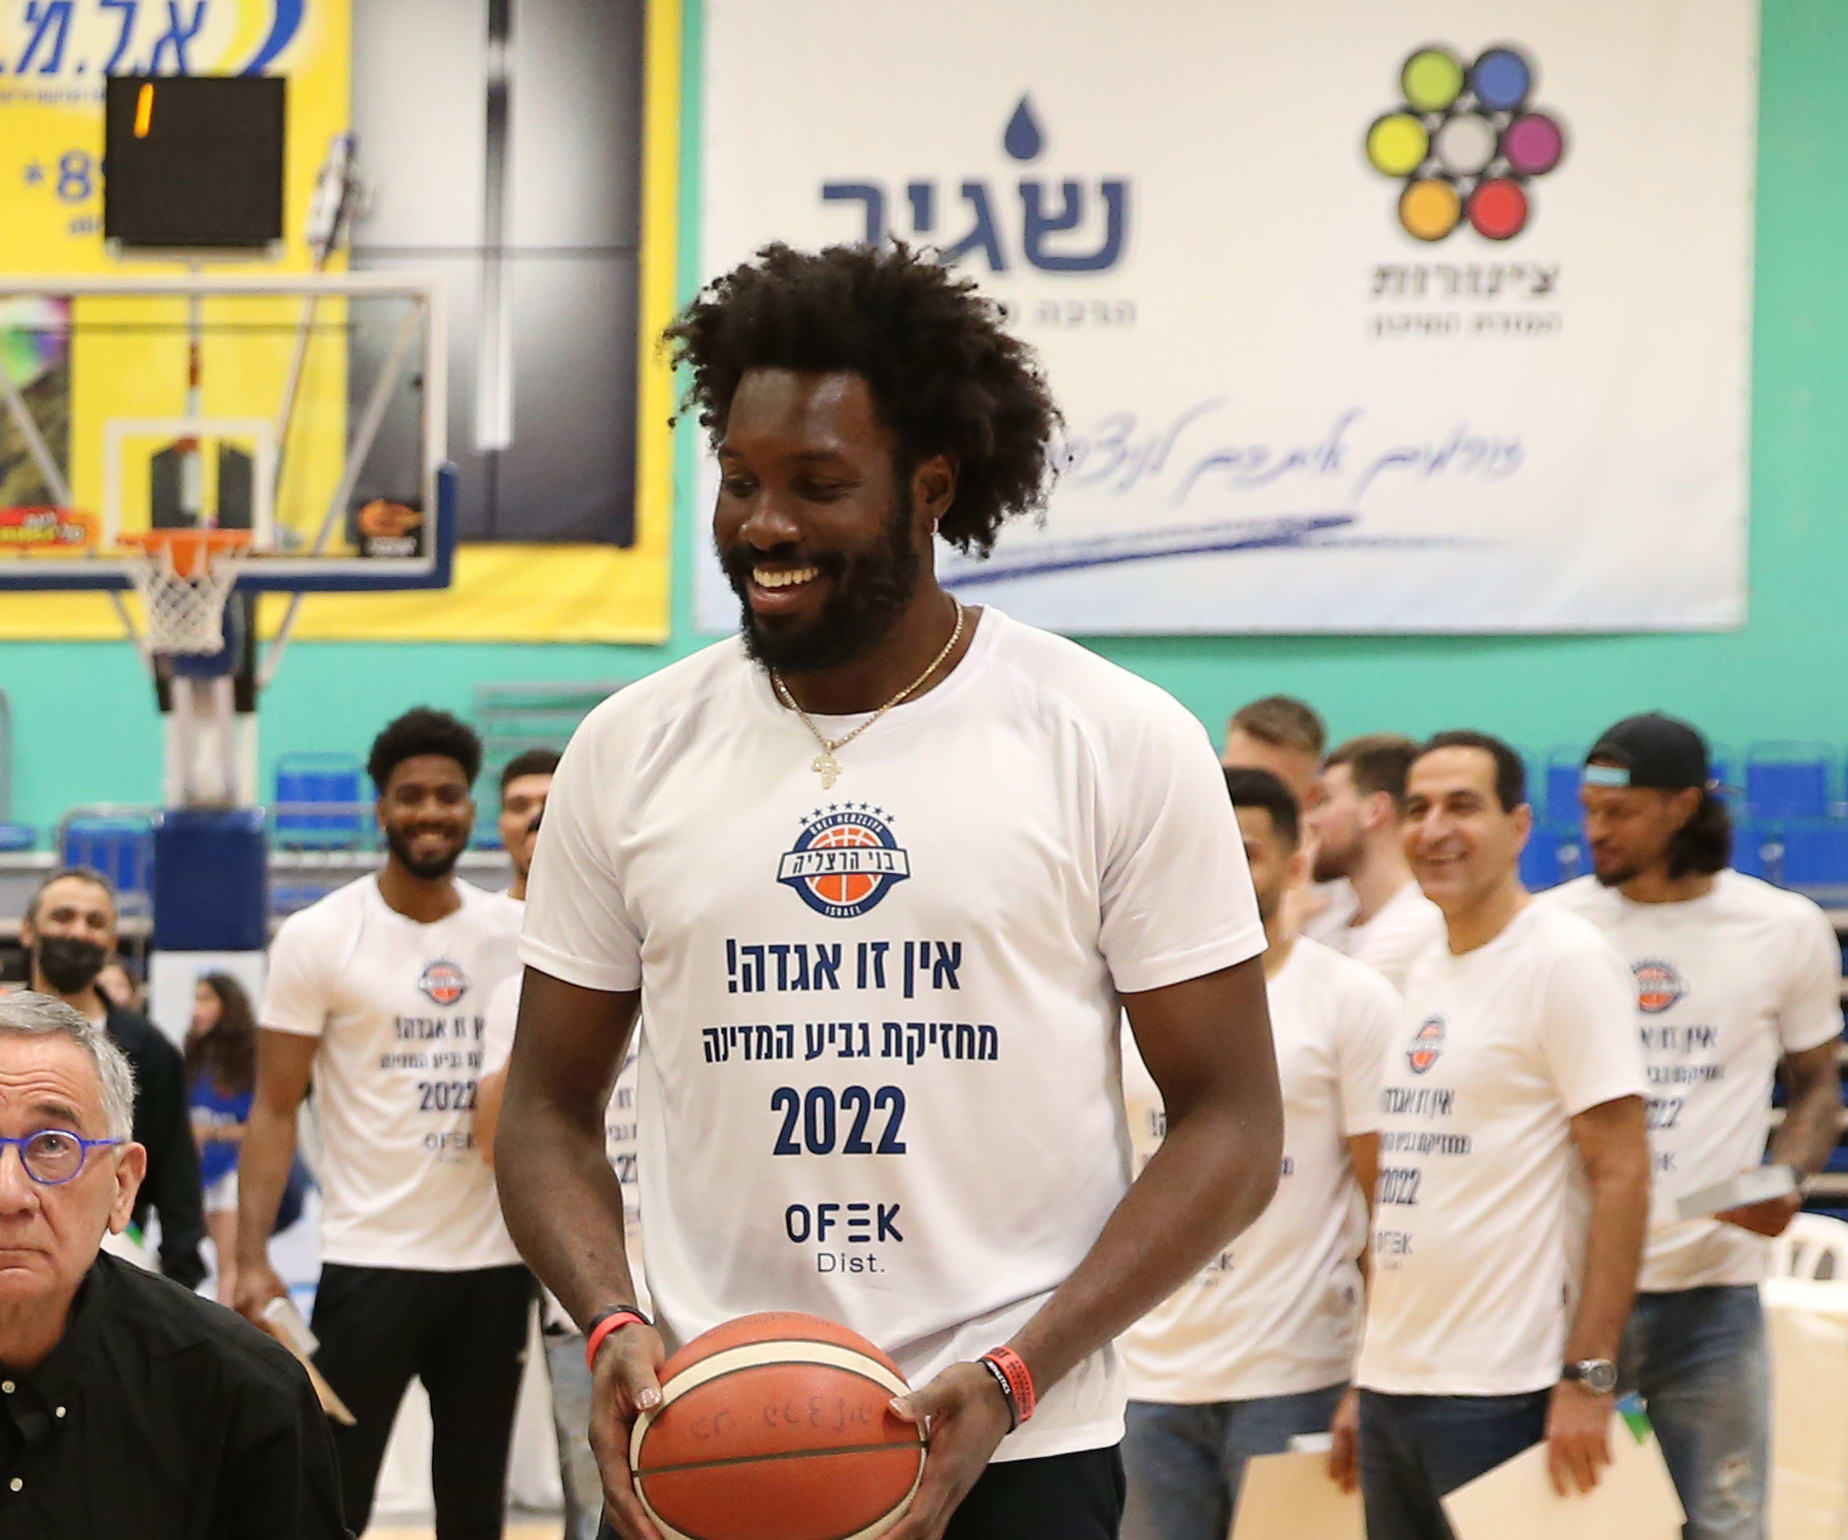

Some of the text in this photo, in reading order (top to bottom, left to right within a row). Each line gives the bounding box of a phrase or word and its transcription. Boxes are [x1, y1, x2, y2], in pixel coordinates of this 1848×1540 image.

[822, 181, 1125, 273] שגיר
[792, 851, 896, 874] בני הרצליה
[824, 904, 862, 918] ISRAEL
[725, 938, 961, 999] אין זו אגדה!
[702, 1021, 998, 1066] מחזיקת גביע המדינה
[770, 1084, 907, 1156] 2022
[1378, 1167, 1422, 1205] 022
[785, 1202, 904, 1244] OFEK
[816, 1252, 887, 1274] Dist.
